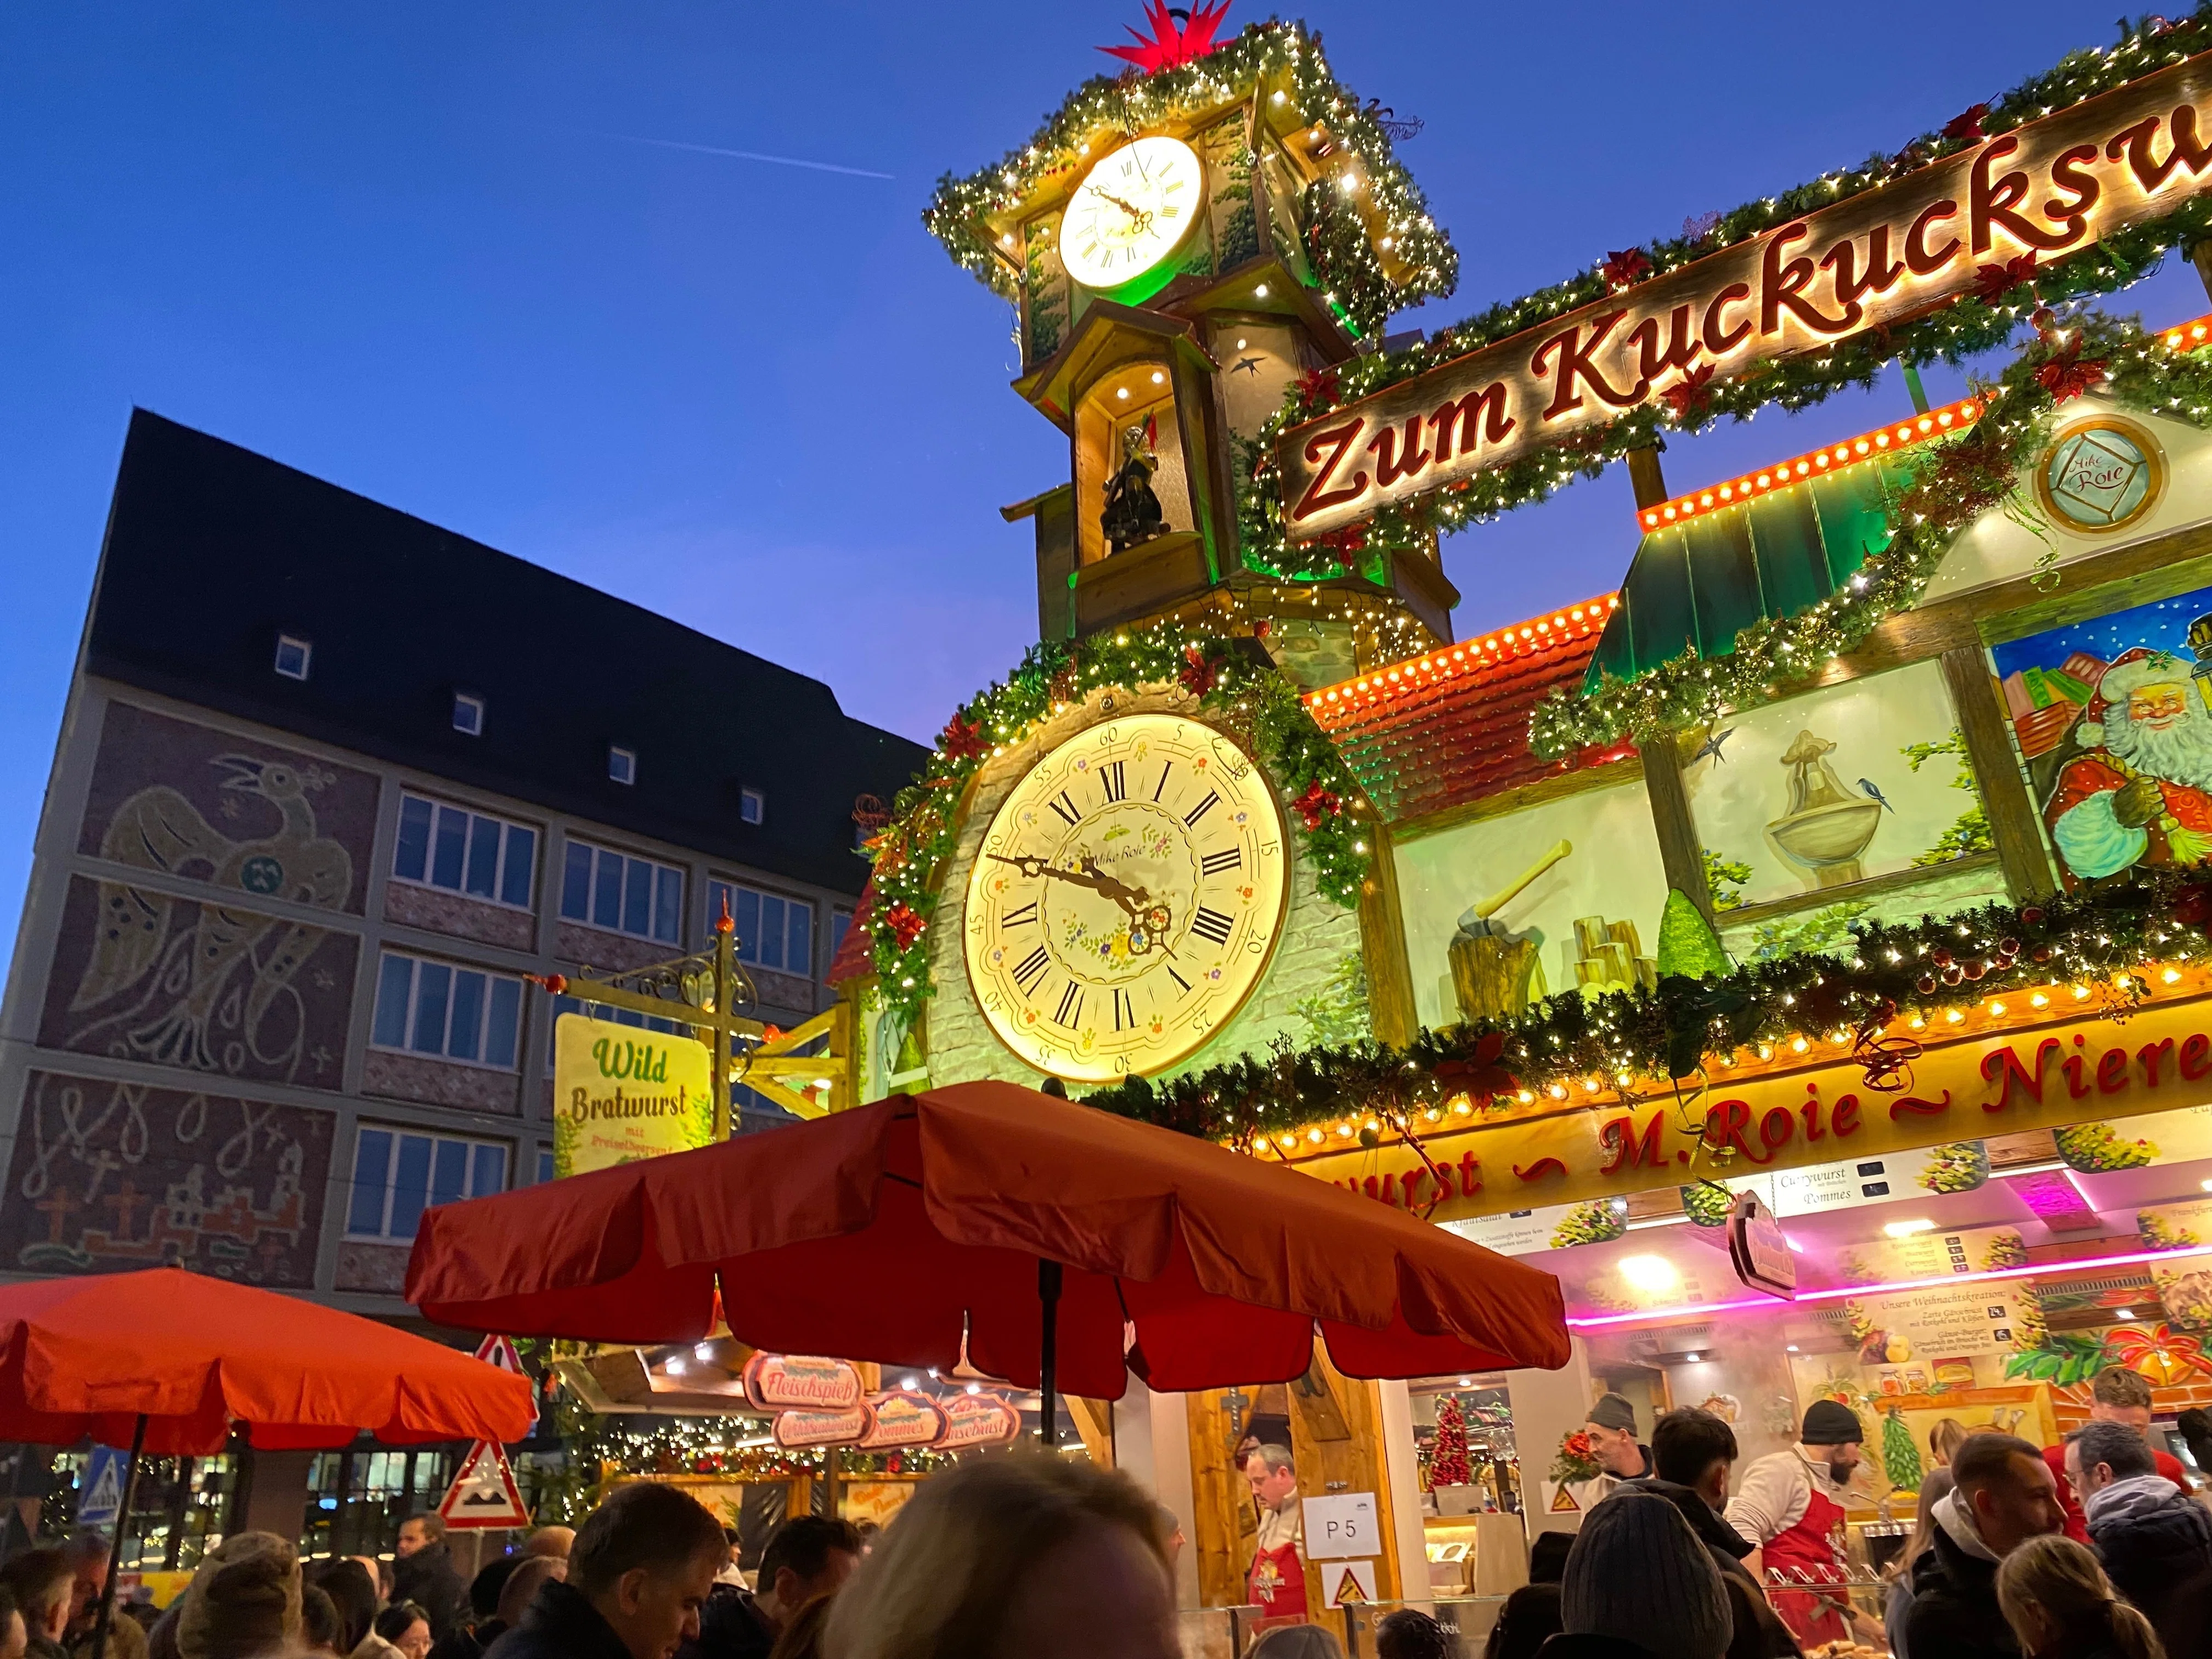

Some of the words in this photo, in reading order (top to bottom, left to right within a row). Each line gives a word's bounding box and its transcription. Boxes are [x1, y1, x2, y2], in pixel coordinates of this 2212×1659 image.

[1293, 381, 1516, 522] Zum
[2069, 454, 2102, 472] Mike
[2069, 466, 2125, 493] Roie
[1099, 727, 1118, 746] 60
[1173, 724, 1185, 741] 5
[1034, 763, 1052, 788] 55
[1094, 759, 1131, 809] XII
[1045, 786, 1087, 839] XI
[1181, 786, 1223, 832] II
[1200, 843, 1242, 882] III
[1261, 839, 1279, 856] 15
[969, 914, 984, 935] 45
[1001, 895, 1039, 935] IX
[1188, 899, 1237, 951] IIII
[1247, 928, 1267, 954] 20
[1009, 941, 1052, 1002] VIII
[1166, 963, 1195, 1003] V
[984, 991, 1002, 1012] 40
[1048, 978, 1086, 1031] VII
[1109, 987, 1141, 1034] VI
[1192, 1008, 1213, 1036] 25
[592, 1037, 668, 1084] Wild
[1114, 1053, 1133, 1074] 30
[571, 1085, 687, 1124] Bratwurst
[1333, 1150, 1483, 1209] urst
[1980, 1033, 2212, 1114] Niere
[1803, 1190, 1851, 1205] Pommes
[1880, 1300, 1911, 1310] Unsere
[767, 1372, 853, 1406] Fleischspieß
[878, 1421, 924, 1438] ommes
[1327, 1521, 1339, 1539] P
[1345, 1520, 1356, 1538] 5
